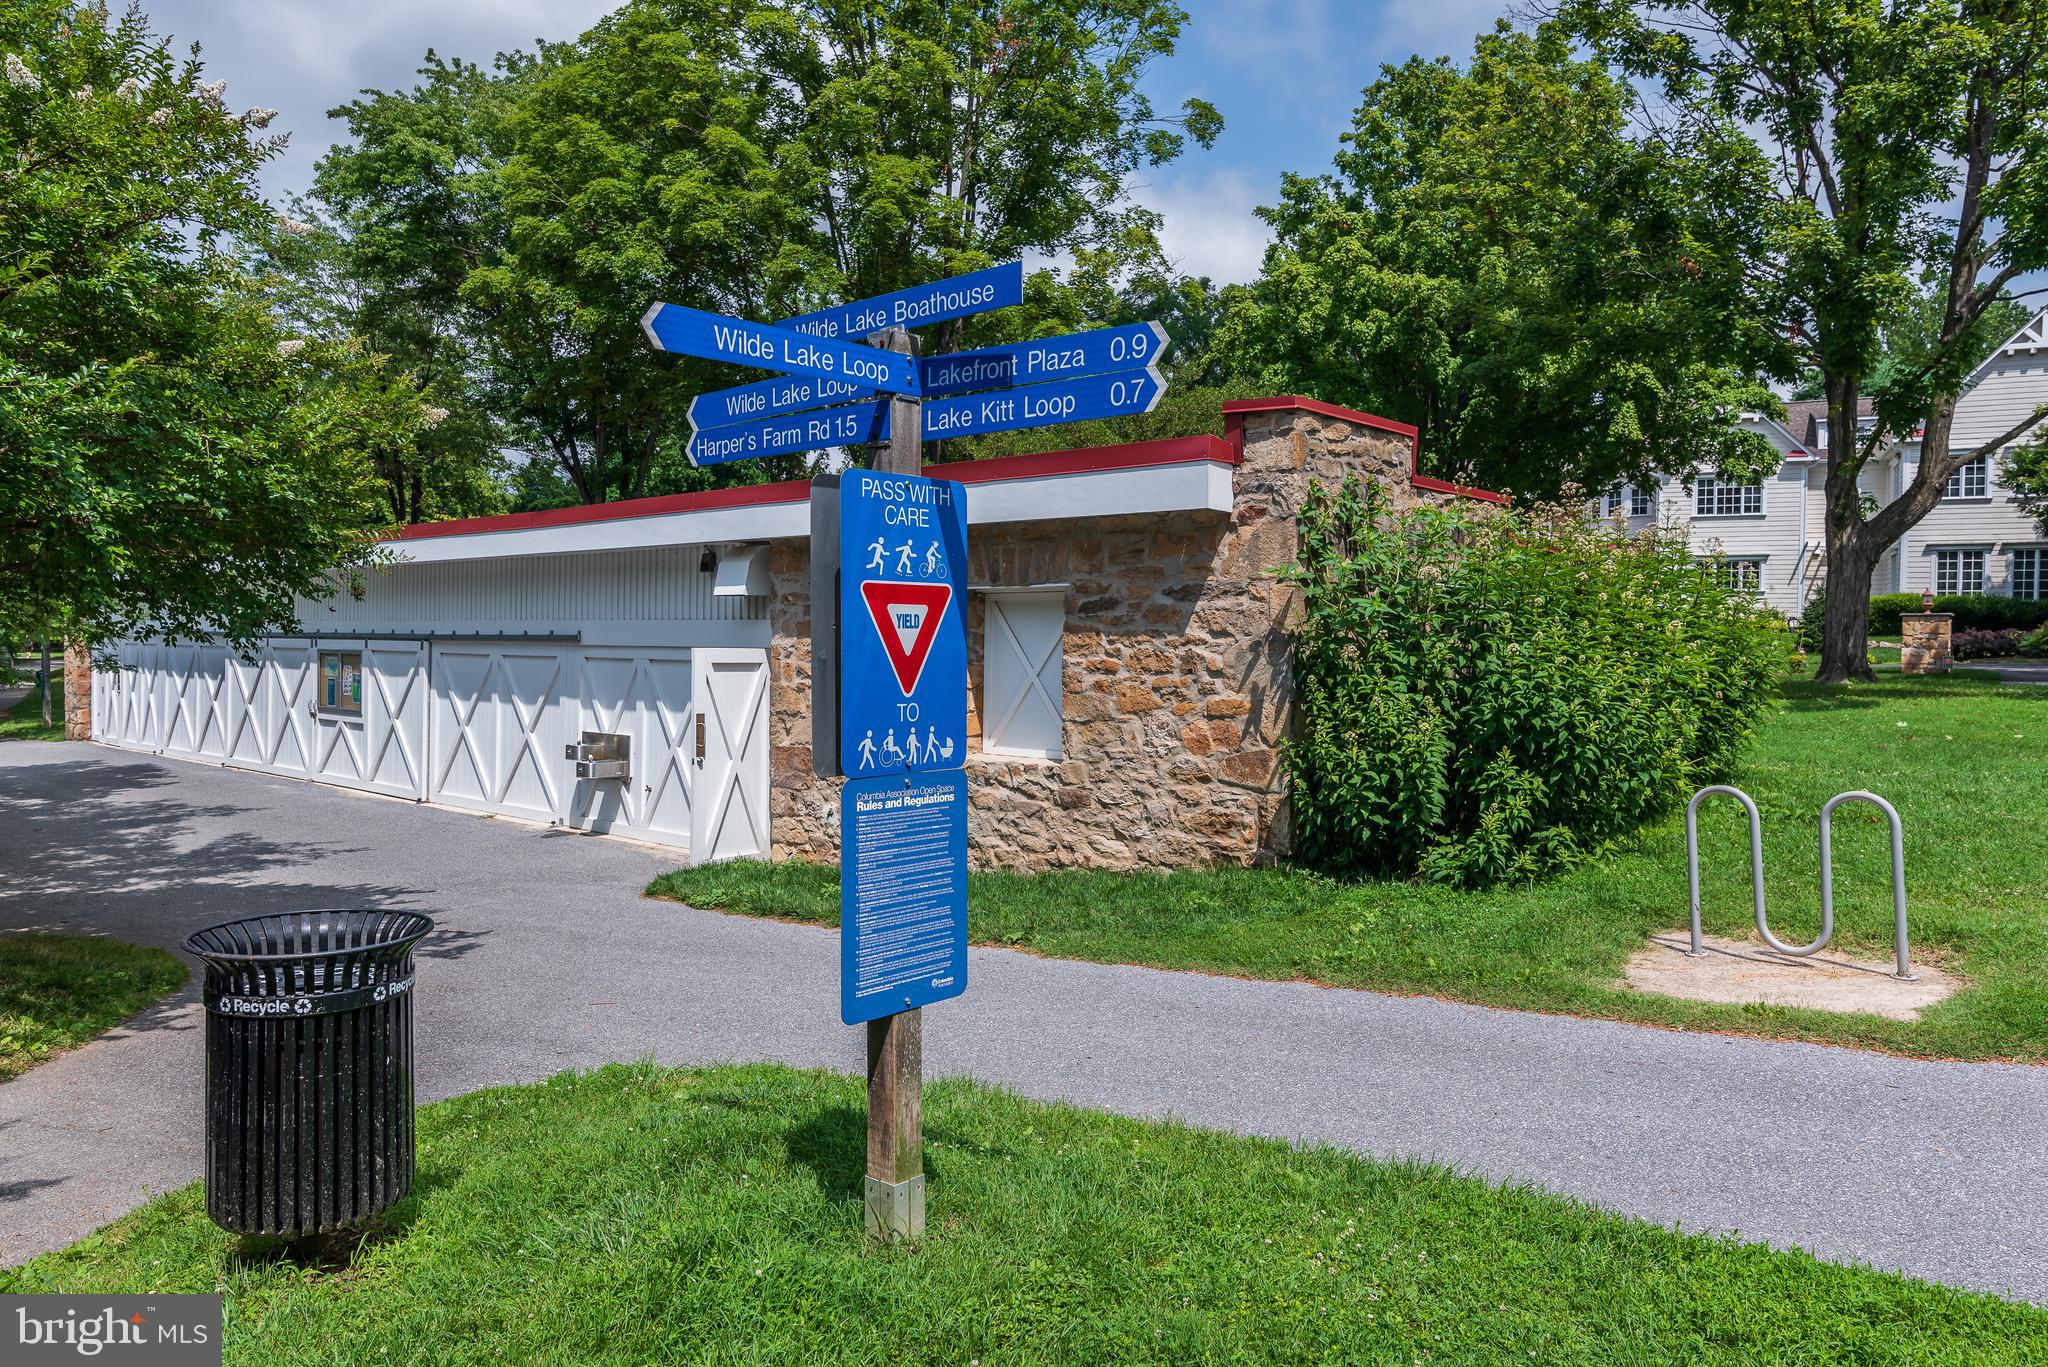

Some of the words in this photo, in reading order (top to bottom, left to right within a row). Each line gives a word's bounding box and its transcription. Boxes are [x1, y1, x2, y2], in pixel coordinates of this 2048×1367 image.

[795, 318, 838, 338] Wilde
[845, 308, 886, 333] Lake
[894, 284, 994, 322] Boathouse
[714, 325, 774, 360] Wilde
[784, 339, 834, 371] Lake
[843, 351, 889, 385] Loop
[927, 355, 1018, 388] Lakefront
[1028, 349, 1085, 374] Plaza
[1110, 333, 1148, 362] 0.9
[726, 392, 766, 416] Wilde
[772, 383, 810, 407] Lake
[818, 378, 858, 397] Loop
[927, 407, 973, 432] Lake
[981, 400, 1014, 424] Kitt
[1024, 395, 1076, 418] Loop
[1110, 378, 1146, 407] 0.7
[697, 430, 757, 459] Harper's
[763, 426, 801, 448] Farm
[808, 419, 830, 441] Rd
[835, 415, 857, 438] 1.5
[861, 478, 905, 502] PASS
[909, 484, 950, 506] WITH
[885, 505, 929, 527] CARE
[896, 613, 920, 629] YIELD
[896, 702, 920, 722] TO
[856, 792, 885, 801] Columbia
[886, 788, 919, 799] Association
[920, 785, 936, 796] Open
[936, 784, 955, 795] Space
[856, 800, 883, 812] Rules
[885, 797, 902, 809] and
[903, 793, 955, 807] Regulations
[233, 999, 290, 1016] Recycle
